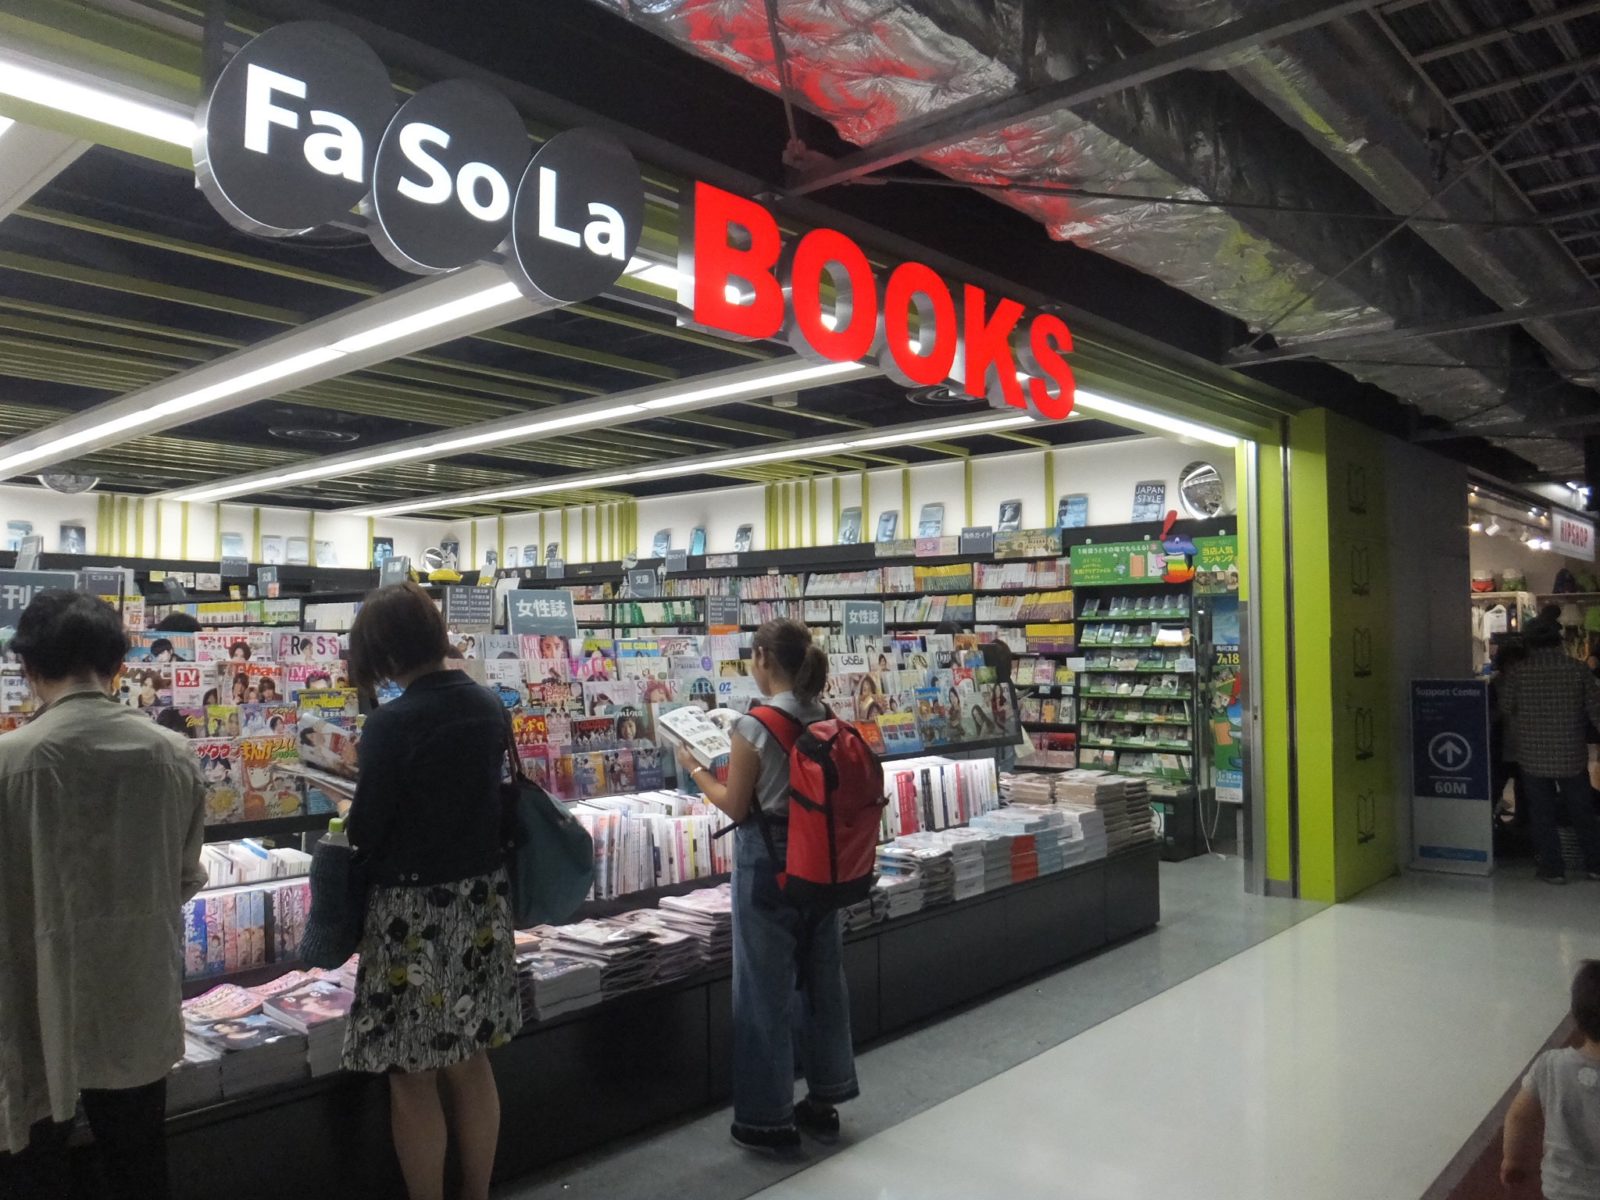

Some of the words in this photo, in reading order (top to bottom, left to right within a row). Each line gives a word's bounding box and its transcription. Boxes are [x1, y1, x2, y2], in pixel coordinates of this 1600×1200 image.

[243, 62, 366, 184] Fa
[397, 121, 511, 222] So
[538, 167, 628, 261] La
[693, 180, 1076, 421] BOOKS
[1135, 485, 1165, 495] JAPAN
[1135, 494, 1163, 504] STYLE
[1202, 546, 1233, 555] 当店人気
[516, 599, 568, 618] 女性誌
[849, 609, 880, 625] 女性誌
[278, 634, 338, 656] CRSS
[178, 669, 198, 681] TV
[1415, 686, 1450, 698] Support
[1452, 687, 1482, 697] Center
[1434, 780, 1468, 795] 60M
